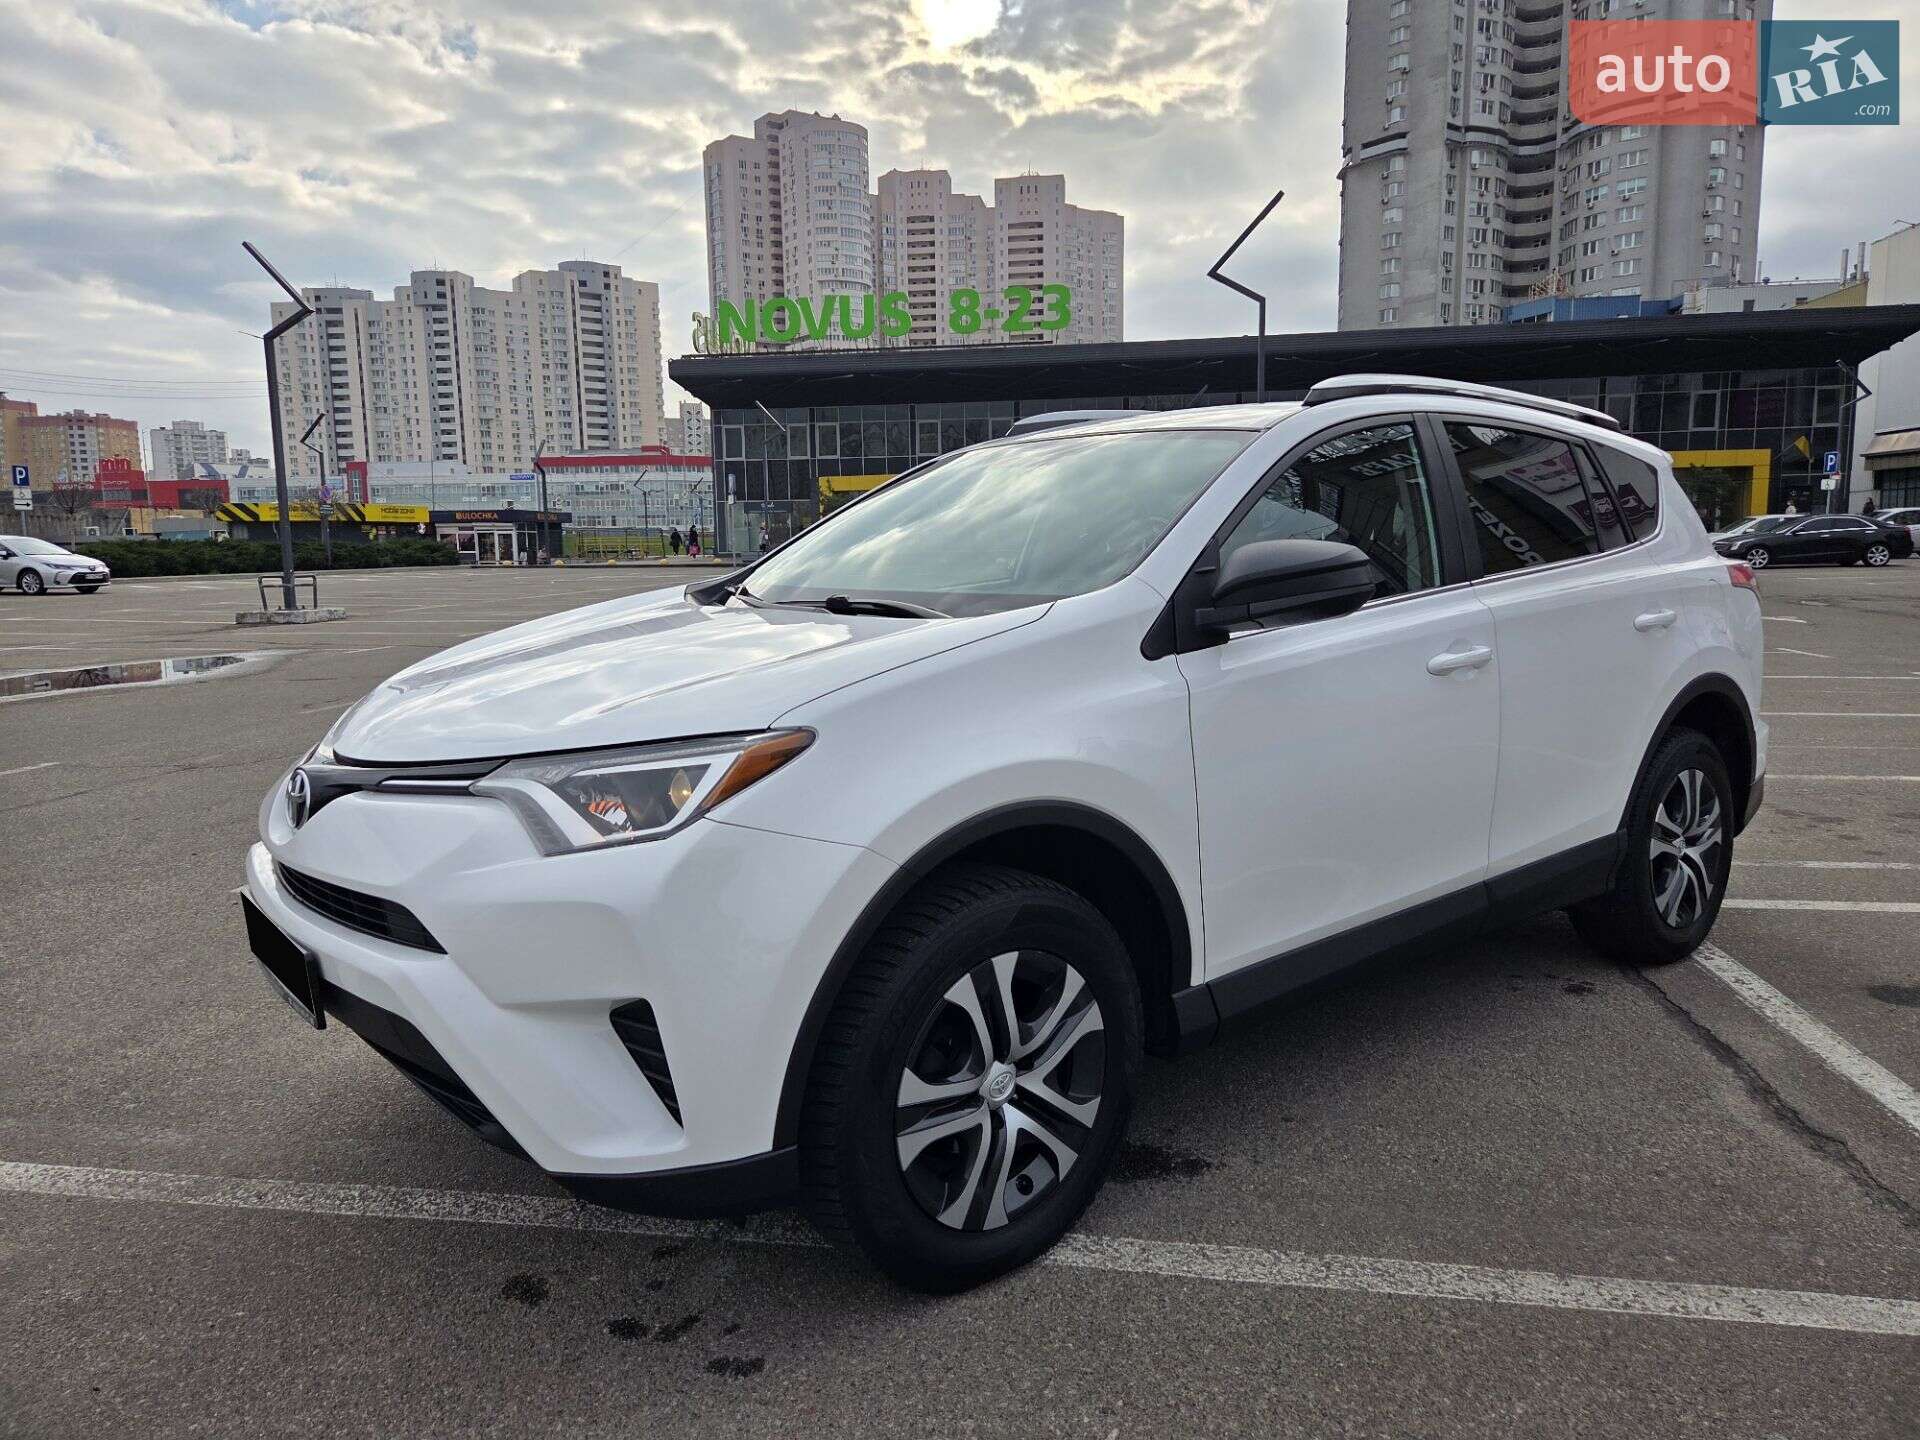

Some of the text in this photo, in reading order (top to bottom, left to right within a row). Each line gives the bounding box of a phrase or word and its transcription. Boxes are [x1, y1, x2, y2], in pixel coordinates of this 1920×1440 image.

[718, 291, 912, 344] NOVUS
[948, 283, 1072, 335] 8-23
[1827, 454, 1836, 471] P
[15, 467, 26, 484] P
[455, 511, 499, 520] BULOCHKA
